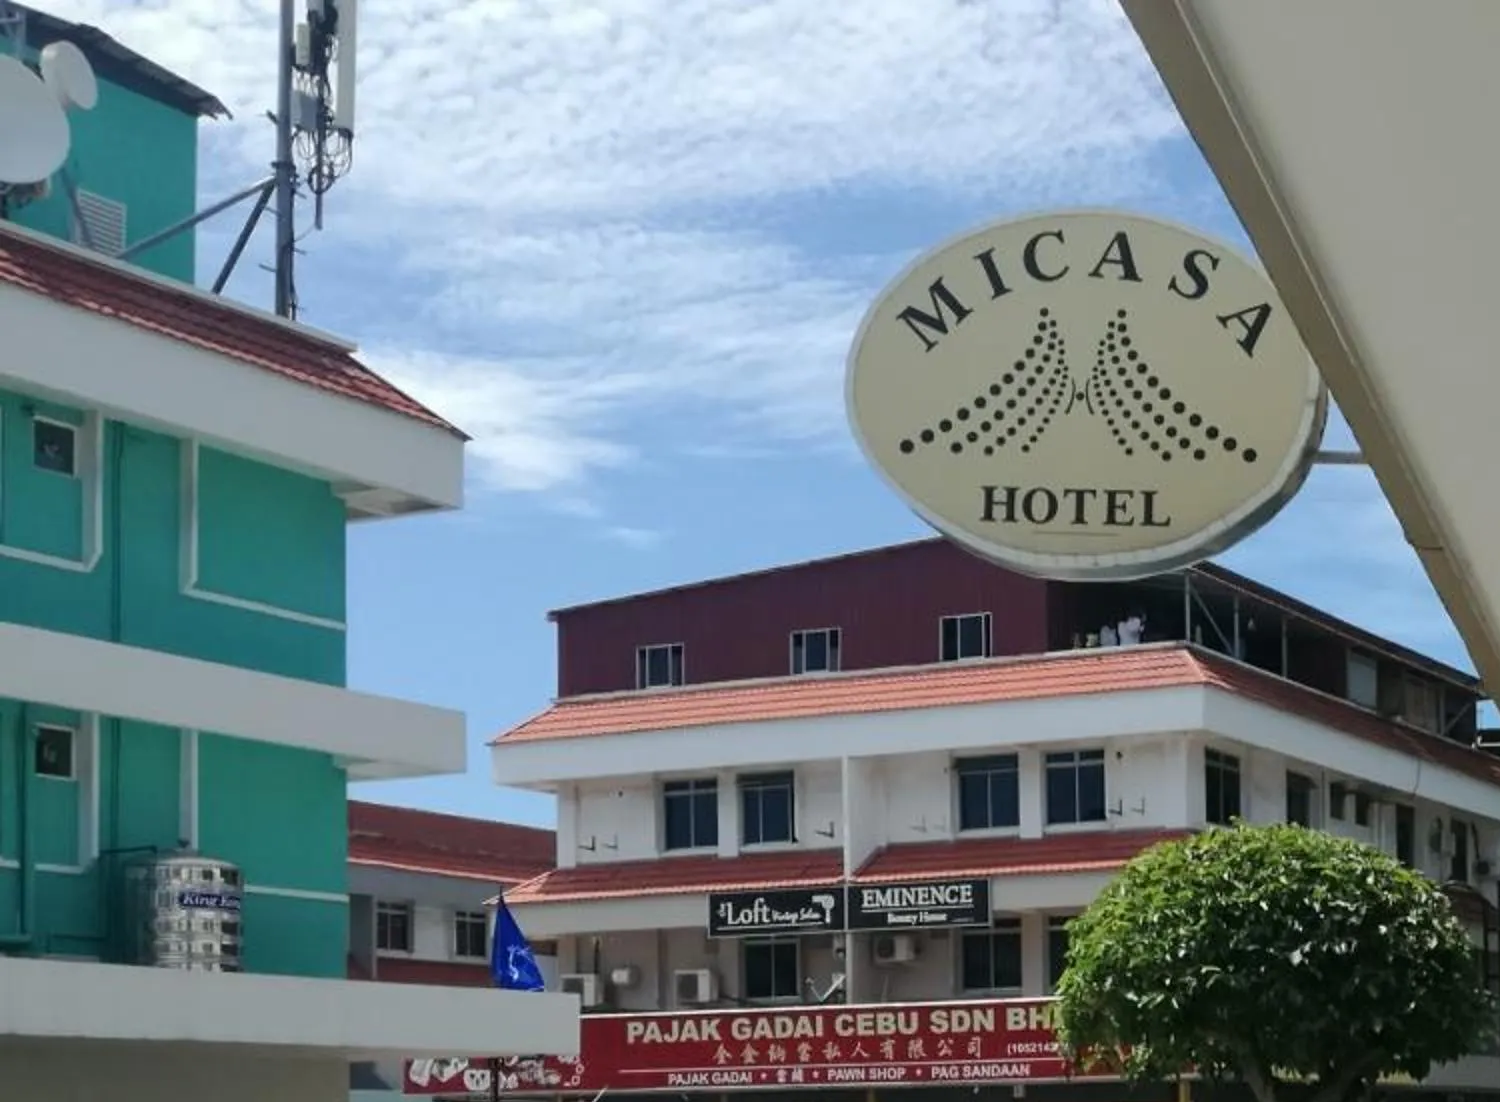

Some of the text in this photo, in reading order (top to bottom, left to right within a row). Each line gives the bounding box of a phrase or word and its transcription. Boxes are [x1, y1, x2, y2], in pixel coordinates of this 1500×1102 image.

[896, 229, 1273, 358] MICASA
[979, 485, 1172, 528] HOTEL
[727, 897, 770, 925] Loft
[861, 884, 973, 908] EMINENCE
[626, 1018, 723, 1044] PAJAK
[731, 1015, 824, 1041] GADAI
[835, 1010, 920, 1037] CEBU
[929, 1007, 995, 1035] SDN
[668, 1072, 709, 1086] PAJAK
[711, 1071, 753, 1084] GADAI
[827, 1068, 866, 1081] PAWN
[869, 1067, 906, 1080] SHOP
[931, 1064, 960, 1078] PAG
[963, 1063, 1030, 1077] SANDAAN
